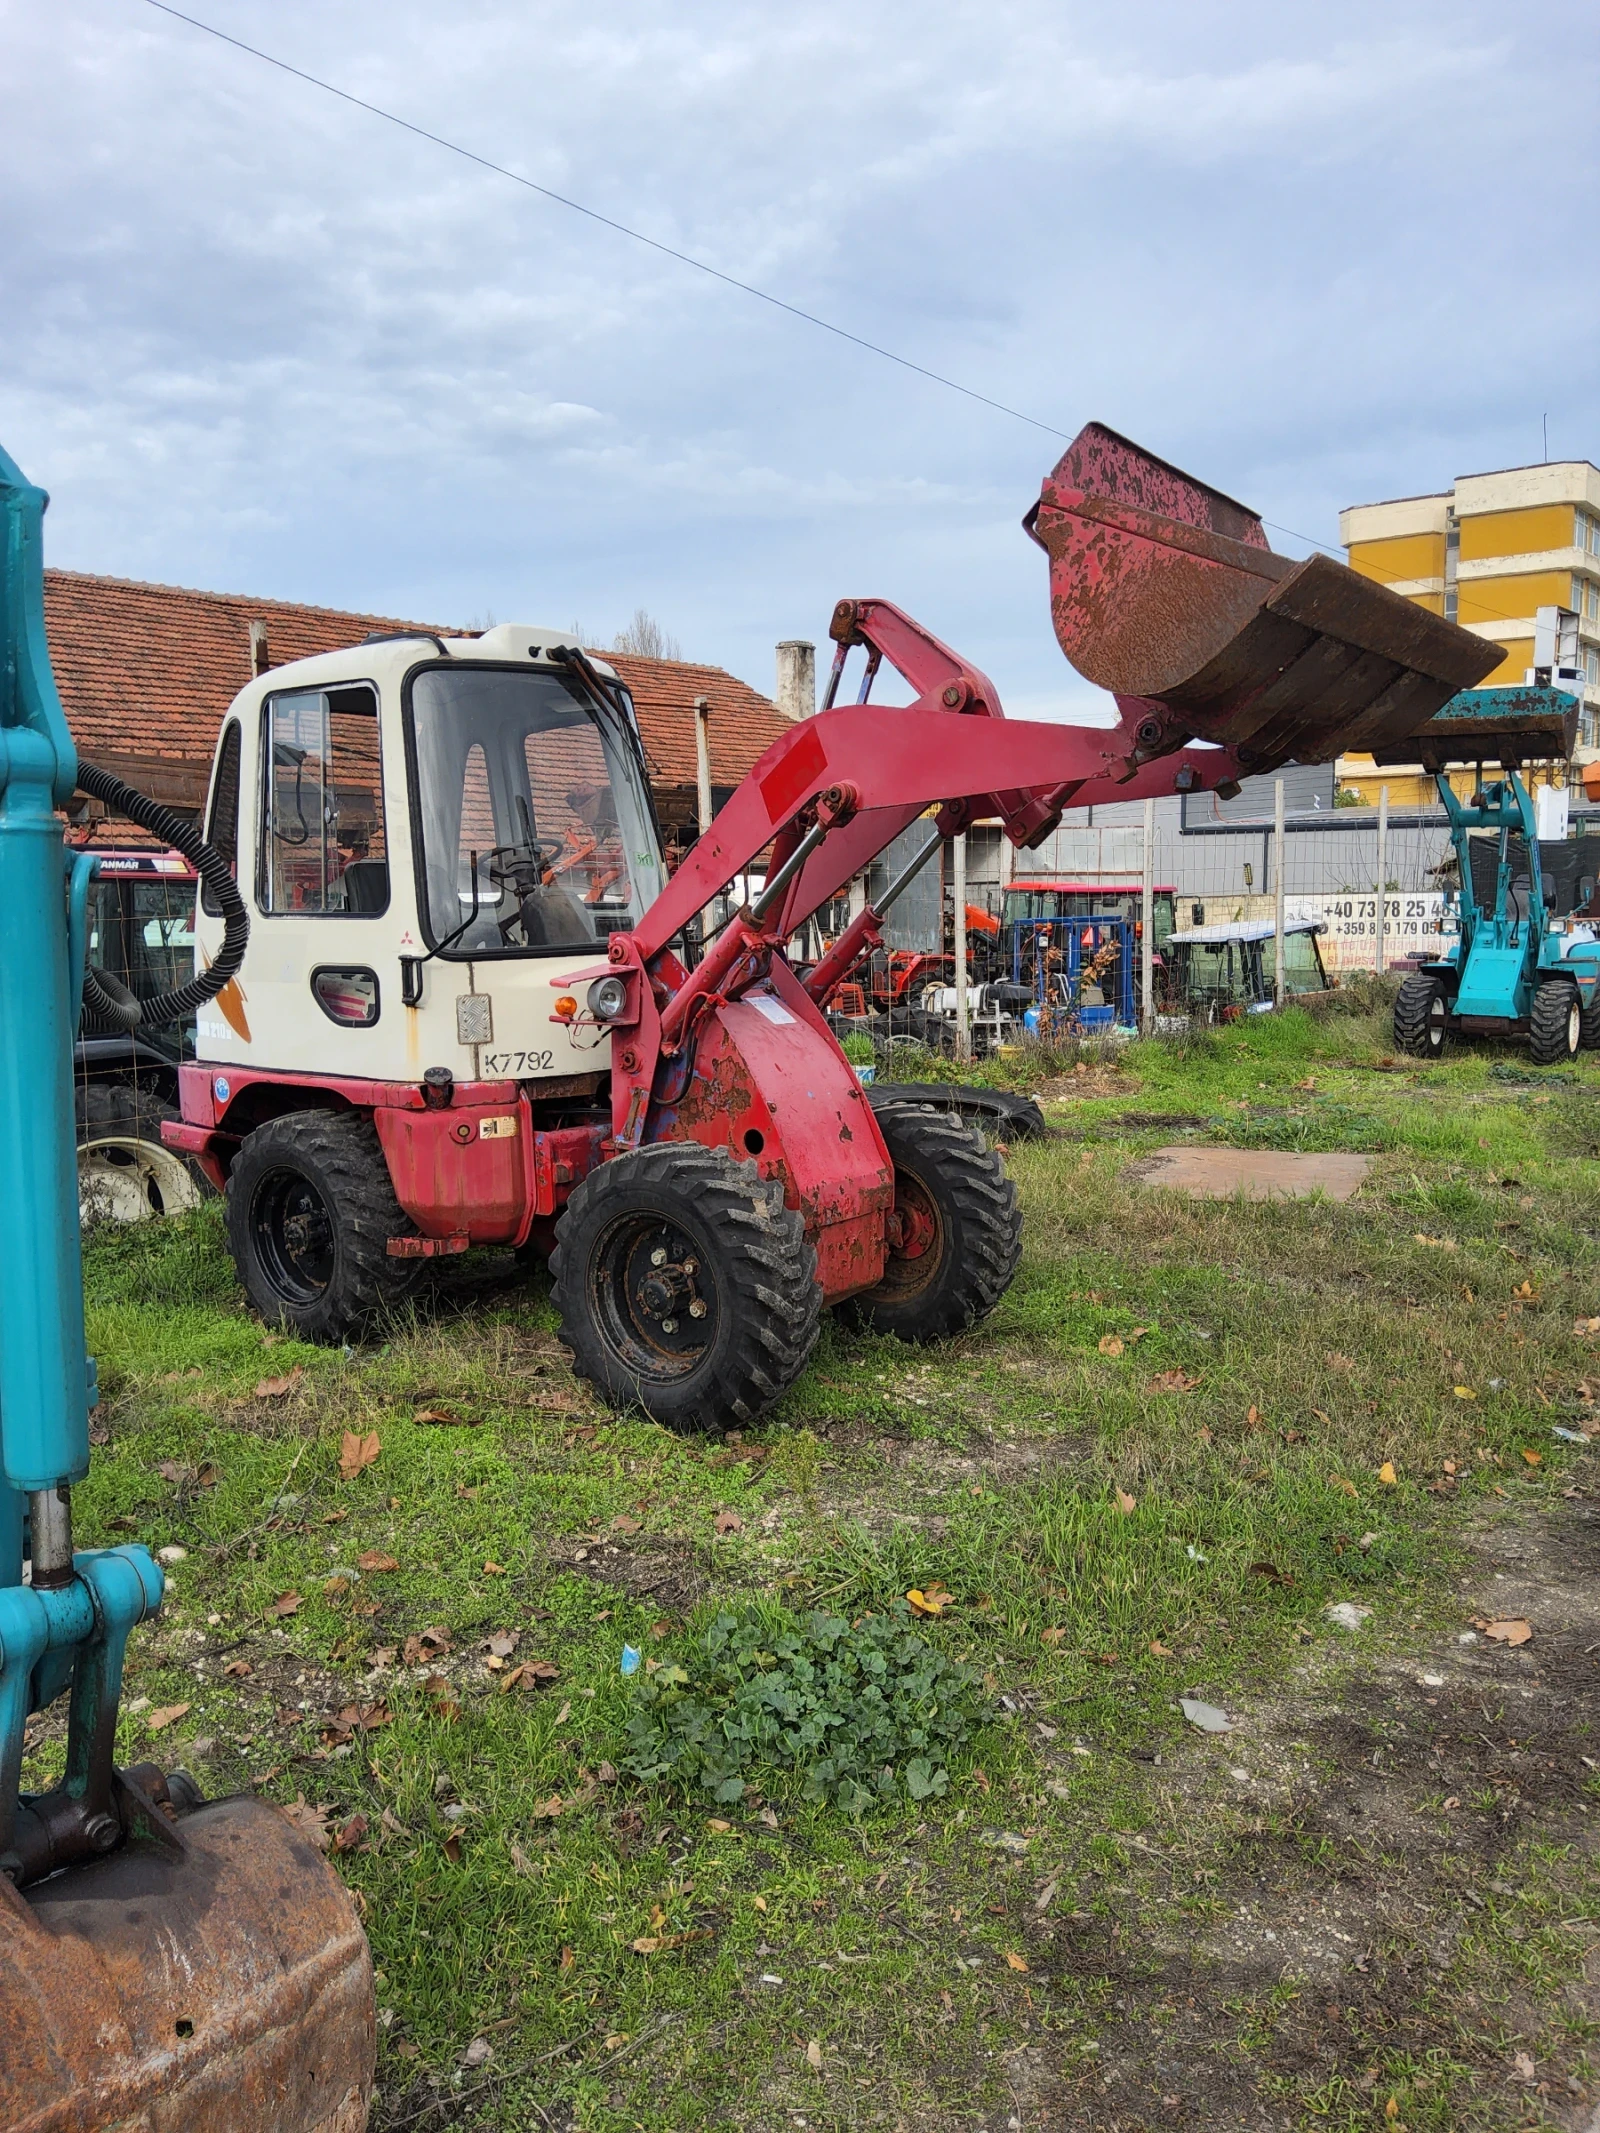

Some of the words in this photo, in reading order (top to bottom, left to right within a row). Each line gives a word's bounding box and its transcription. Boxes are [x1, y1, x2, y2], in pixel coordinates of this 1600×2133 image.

[100, 860, 139, 869] ANMAR
[1324, 901, 1352, 918] +40
[1406, 900, 1425, 917] 25
[1336, 922, 1365, 935] +359
[1369, 922, 1391, 935] 89
[1396, 922, 1418, 935] 179
[1422, 921, 1441, 935] 05
[485, 1050, 554, 1074] K7792
